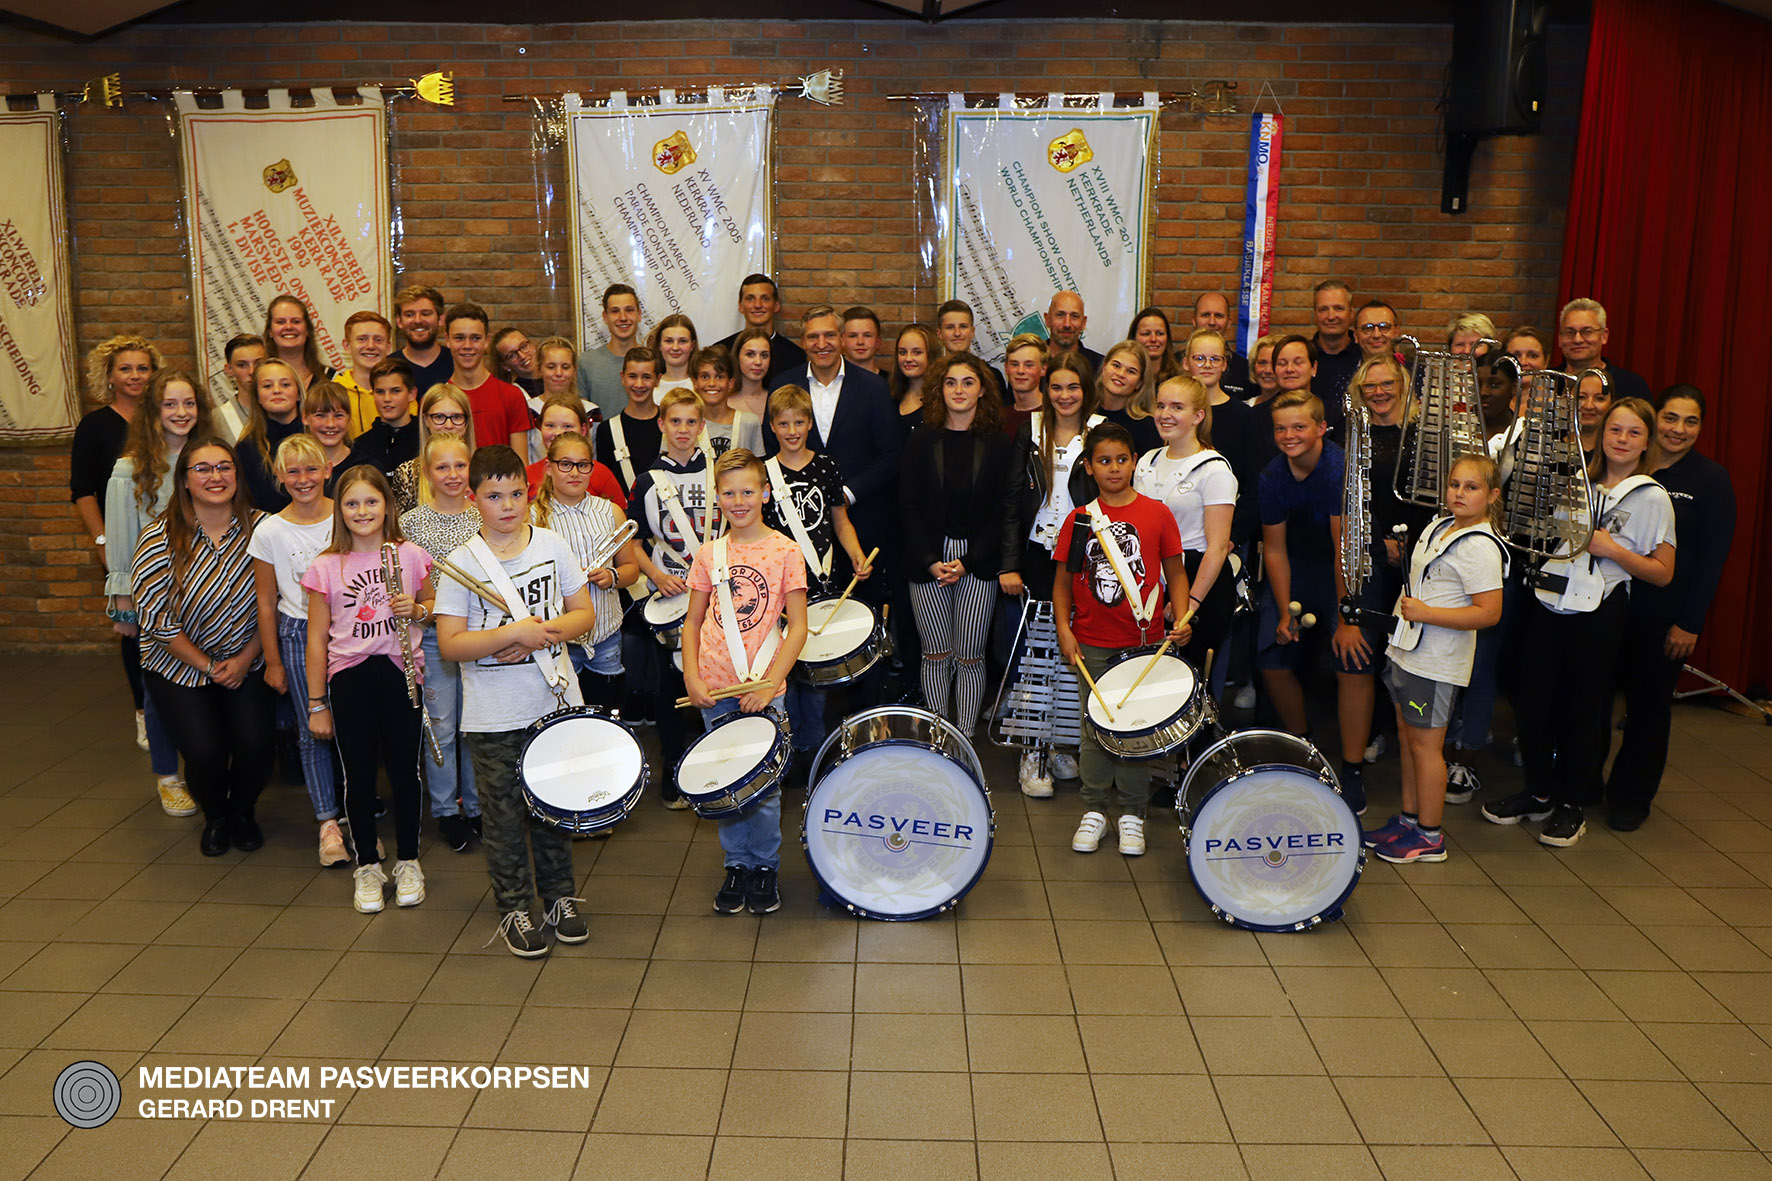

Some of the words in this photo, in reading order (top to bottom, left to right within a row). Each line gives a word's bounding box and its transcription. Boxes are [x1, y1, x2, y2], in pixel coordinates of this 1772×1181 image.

[1257, 121, 1272, 165] KNMO
[625, 189, 649, 227] PARADE
[646, 227, 675, 271] CONTEST
[636, 182, 671, 239] CHAMPION
[666, 238, 699, 291] MARCHING
[671, 183, 711, 249] NEDERLAND
[697, 168, 711, 183] XV
[707, 183, 727, 215] WMC
[722, 215, 743, 244] 2005
[1000, 166, 1023, 208] WORLD
[1019, 209, 1064, 292] CHAMPIONSHIP
[1012, 161, 1044, 219] CHAMPION
[1040, 221, 1061, 255] SHOW
[1066, 177, 1112, 268] NETHERLANDS
[1078, 171, 1115, 237] KERKRADE
[1091, 165, 1110, 194] XVIII
[1105, 194, 1123, 225] WMC
[1119, 226, 1134, 254] 2017
[235, 236, 269, 287] DIVISIE
[240, 215, 291, 296] MARSWEDST
[287, 235, 311, 268] 1993
[293, 187, 359, 302] MUZIEKCONCOURS
[298, 227, 346, 304] KERKRADE
[613, 196, 659, 271] CHAMPIONSHIP
[655, 272, 683, 315] DIVISION
[253, 209, 293, 274] HOOGSTE
[289, 277, 346, 372] ONDERSCHEIDI
[747, 571, 767, 599] JUMP
[352, 616, 397, 639] EDITIO
[823, 808, 974, 841] PASVEER
[1205, 832, 1345, 853] PASVEER
